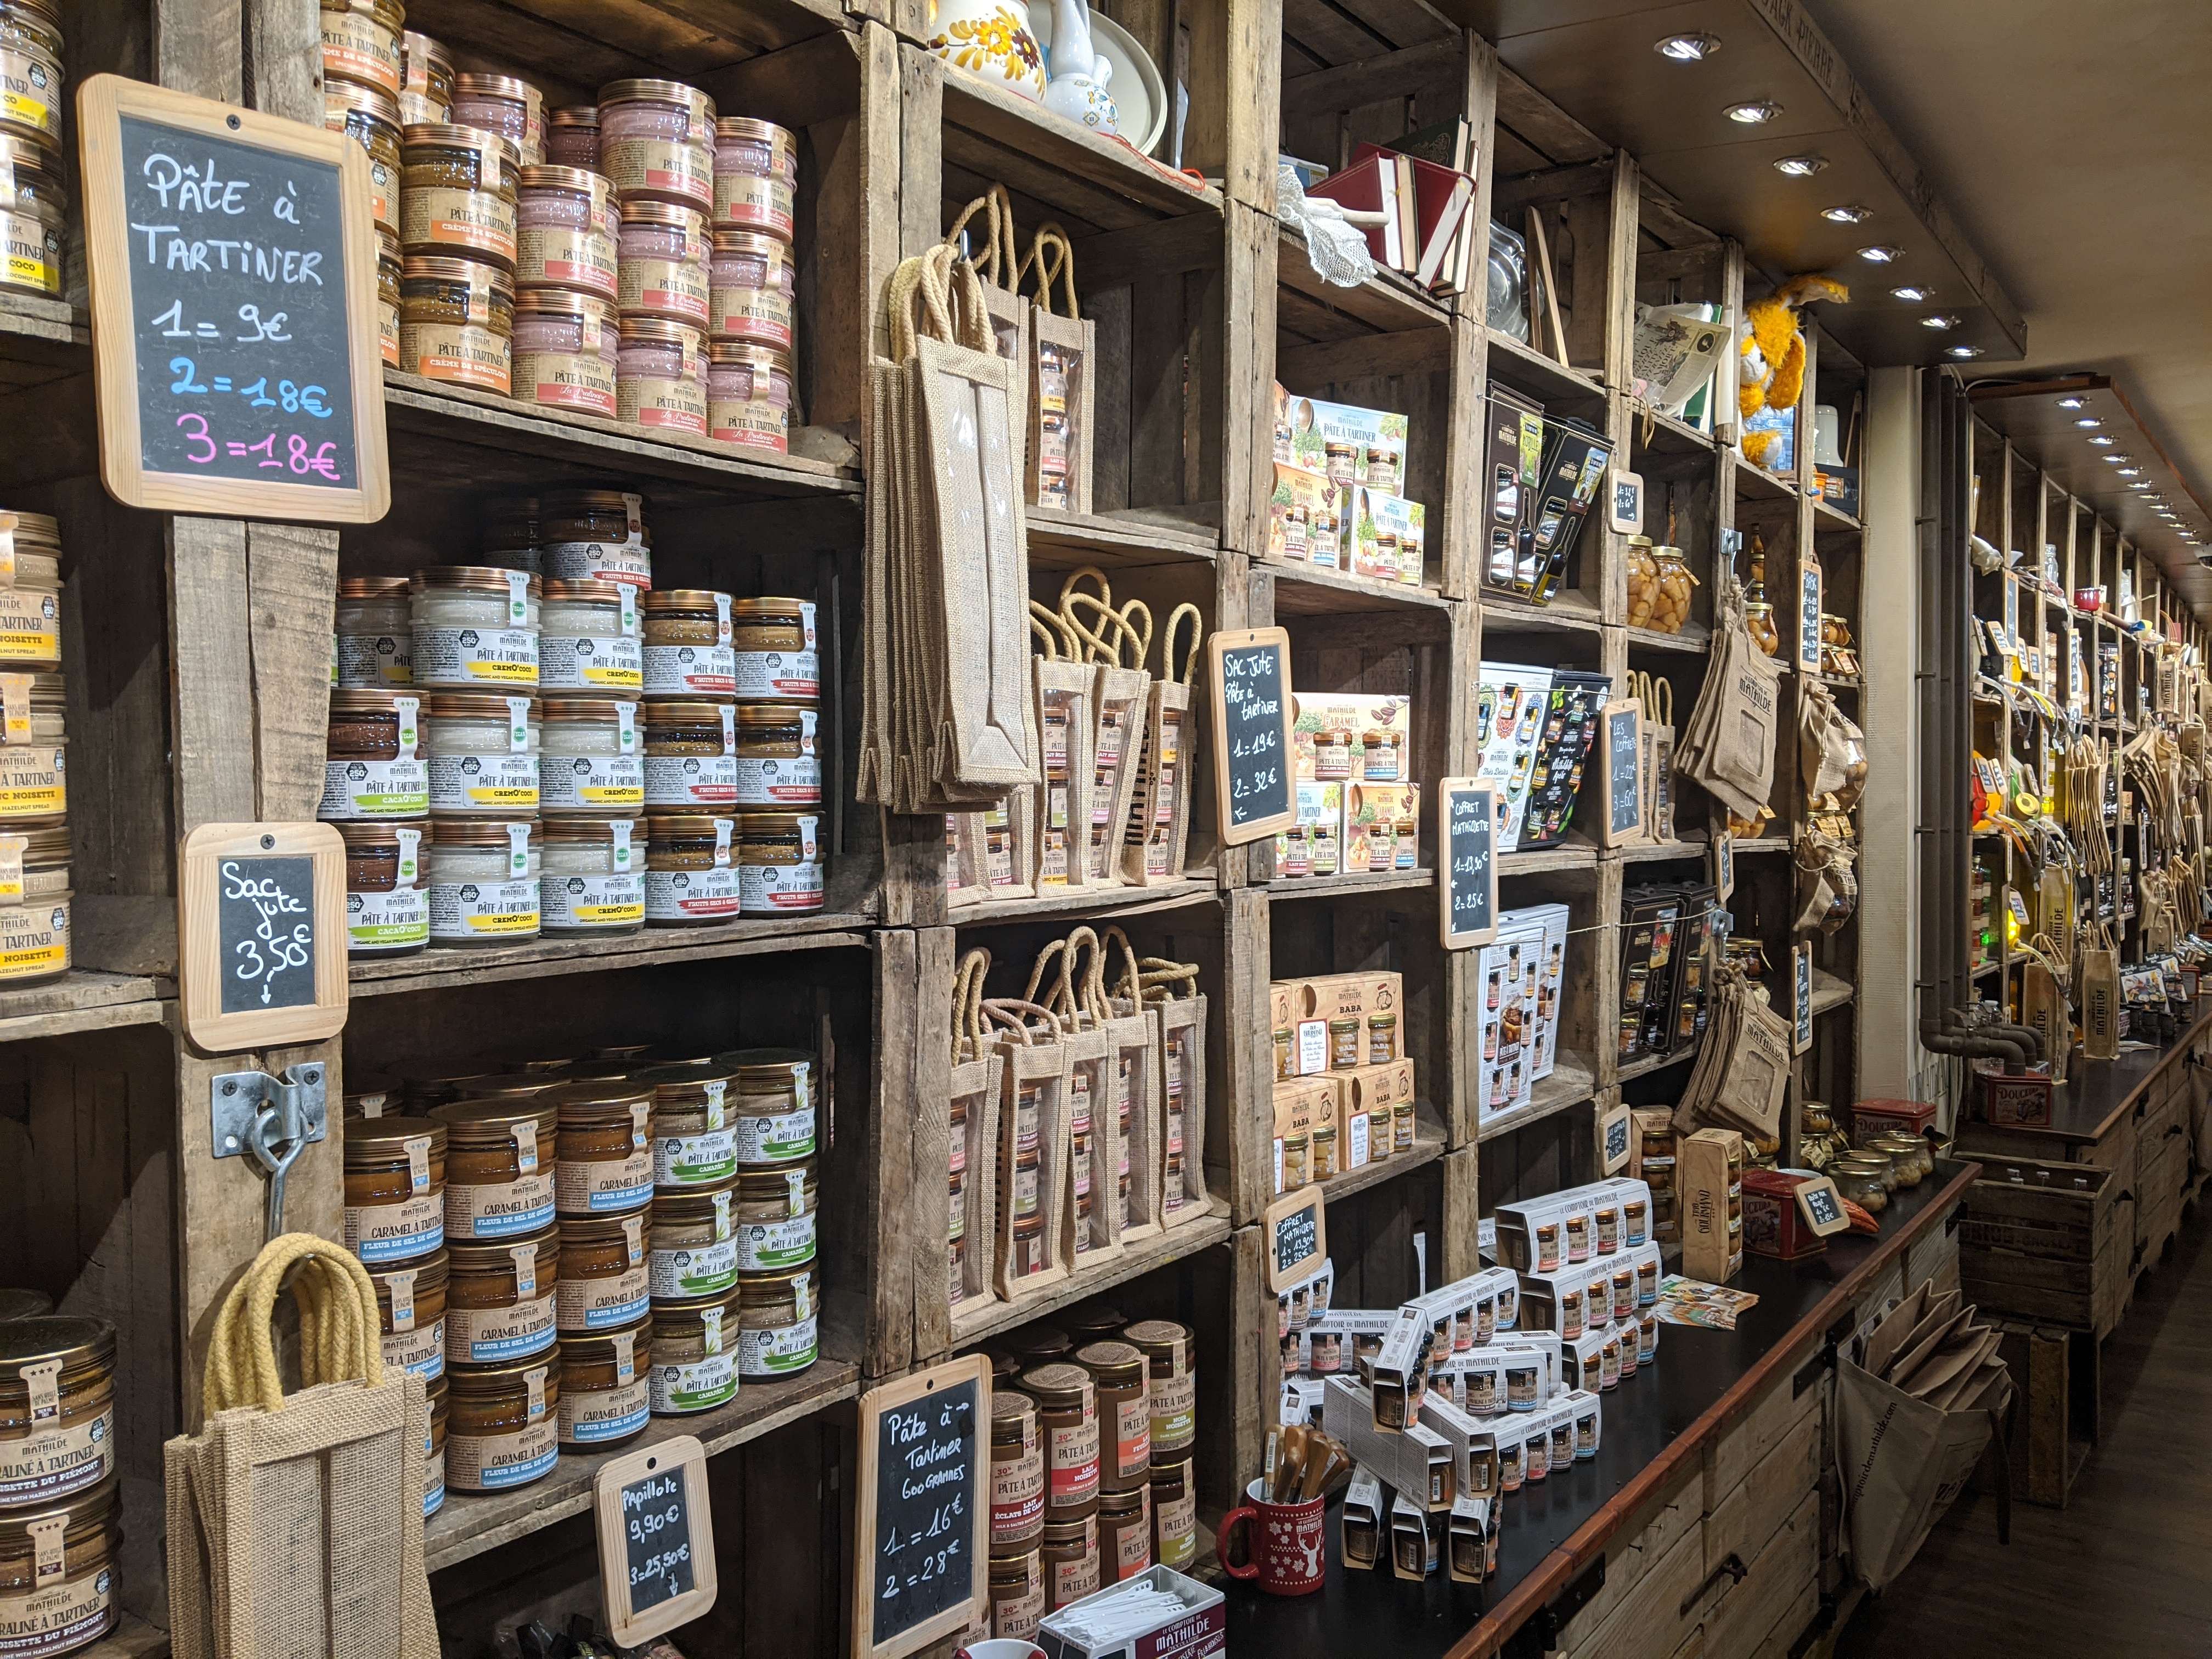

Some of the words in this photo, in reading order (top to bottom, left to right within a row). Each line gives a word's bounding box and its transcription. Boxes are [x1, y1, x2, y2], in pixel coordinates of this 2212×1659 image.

[341, 20, 375, 37] MATHILDE
[356, 38, 390, 62] TARTINER
[470, 198, 501, 213] MATHILDE
[450, 207, 473, 222] PÂTE
[483, 215, 512, 235] TARTINER
[442, 223, 469, 233] CRÈME
[9, 259, 35, 271] COCO
[459, 334, 490, 346] MATHILDE
[438, 342, 461, 355] PÂTE
[472, 350, 504, 367] TARTINER
[430, 358, 459, 369] CRÈME
[474, 362, 506, 380] SPÉCULOOS
[574, 362, 601, 373] MATHILDE
[555, 370, 575, 383] PÂTE
[585, 377, 612, 393] TARTINER
[746, 408, 770, 417] MATHILDE
[729, 416, 747, 428] PÂTE
[755, 420, 781, 434] TARTINER
[1338, 416, 1363, 427] MATHILDE
[1324, 423, 1340, 437] PÂTE
[1348, 430, 1375, 443] TARTINER
[1499, 430, 1516, 445] MATHILDE
[1559, 467, 1577, 479] MATHILDE
[1295, 478, 1313, 491] MATHILDE
[1293, 489, 1314, 506] CARAMEL
[499, 636, 527, 646] MATHILDE
[478, 648, 495, 659] PÂTE
[505, 651, 529, 662] TARTINER
[1740, 678, 1771, 712] MATHILDE
[1323, 714, 1359, 727] CARAMEL
[12, 772, 55, 785] TARTINER
[479, 774, 497, 786] PÂTE
[506, 776, 531, 786] TARTINER
[366, 781, 386, 793] PÂTE
[396, 781, 420, 792] TARTINER
[13, 791, 55, 799] NOISETTE
[584, 893, 601, 905] PÂTE
[1338, 991, 1362, 1000] MATHILDE
[1339, 1005, 1362, 1014] BABA
[2096, 989, 2105, 1035] MATHILDE
[1376, 1093, 1390, 1103] BABA
[1293, 1119, 1310, 1128] BABA
[1595, 1192, 1618, 1206] MATHILDE
[371, 1223, 411, 1239] CARAMEL
[363, 1240, 389, 1251] FLEUR
[404, 1237, 416, 1246] SEL
[1612, 1254, 1632, 1269] MATHILDE
[1454, 1293, 1472, 1306] COMPTOIR
[1476, 1283, 1494, 1296] MATHILDE
[1466, 1357, 1500, 1367] MATHILDE
[1166, 1418, 1190, 1430] NOISETTE
[59, 1461, 99, 1481] PIÉMONT
[1018, 1458, 1039, 1471] MATHILDE
[1082, 1465, 1093, 1474] LAIT
[1074, 1468, 1097, 1481] NOISETTE
[14, 1493, 27, 1502] WITH
[29, 1486, 60, 1499] HAZELNUT
[61, 1481, 78, 1493] FROM
[998, 1478, 1019, 1494] PÂTE
[1021, 1476, 1026, 1491] À
[1023, 1499, 1036, 1508] LAIT
[995, 1508, 1022, 1519] ÉCLATS
[1024, 1507, 1031, 1515] DE
[1296, 1518, 1322, 1533] MATHILDE
[1169, 1616, 1195, 1632] COMPTOIR
[1156, 1618, 1210, 1652] MATHILDE
[1168, 1635, 1199, 1652] CHOCOLATERIE
